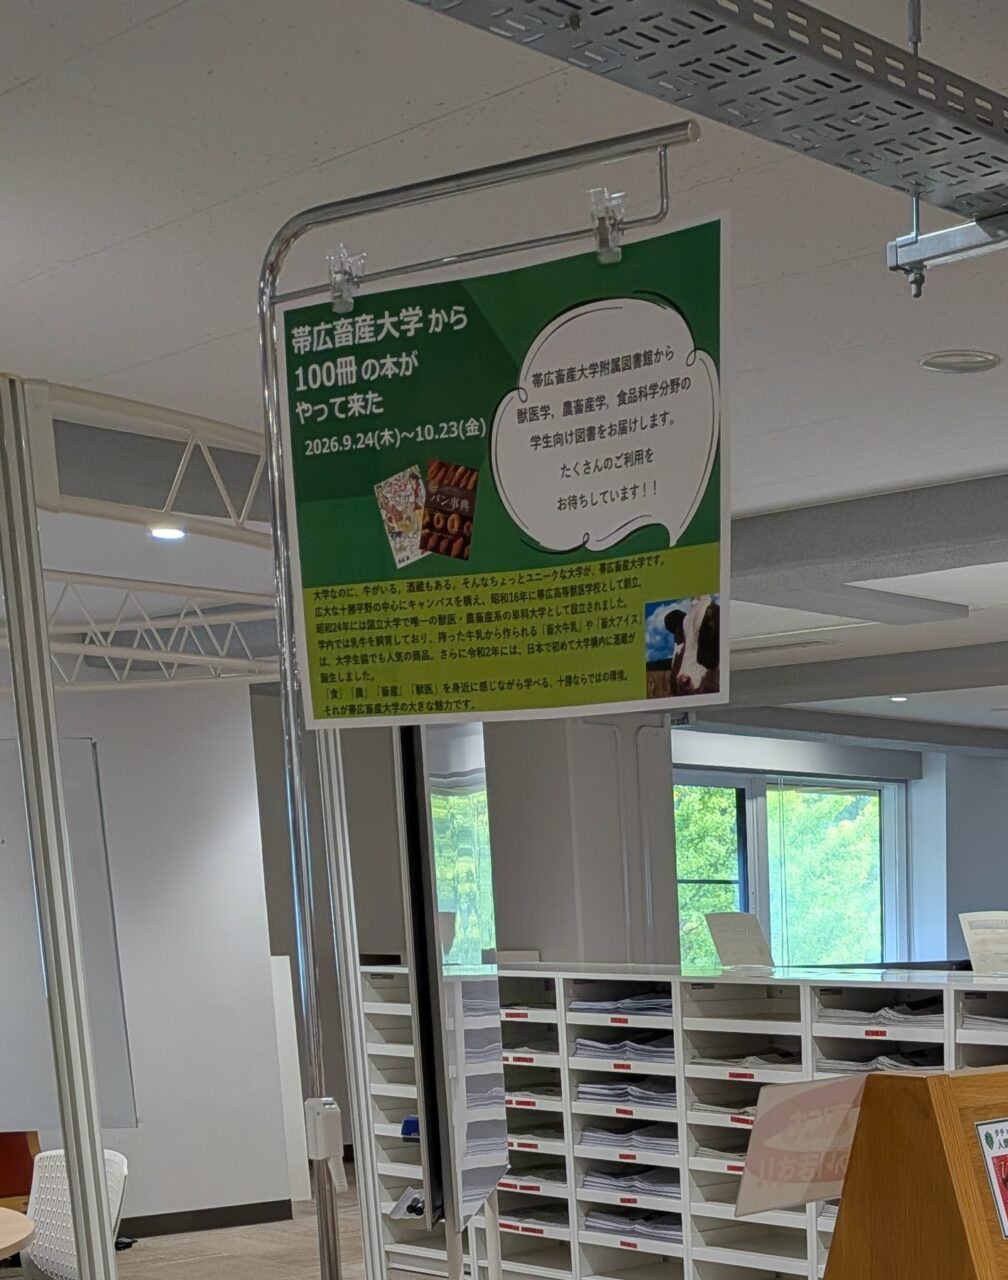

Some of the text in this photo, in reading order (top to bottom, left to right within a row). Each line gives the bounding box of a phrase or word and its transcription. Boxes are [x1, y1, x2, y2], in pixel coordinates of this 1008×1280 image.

[532, 345, 674, 389] 帯広畜産大学附属図書館から
[295, 391, 384, 425] やって来た
[530, 410, 675, 451] 学生向け図書をお届けします。
[560, 448, 654, 479] たくさんのご利用を
